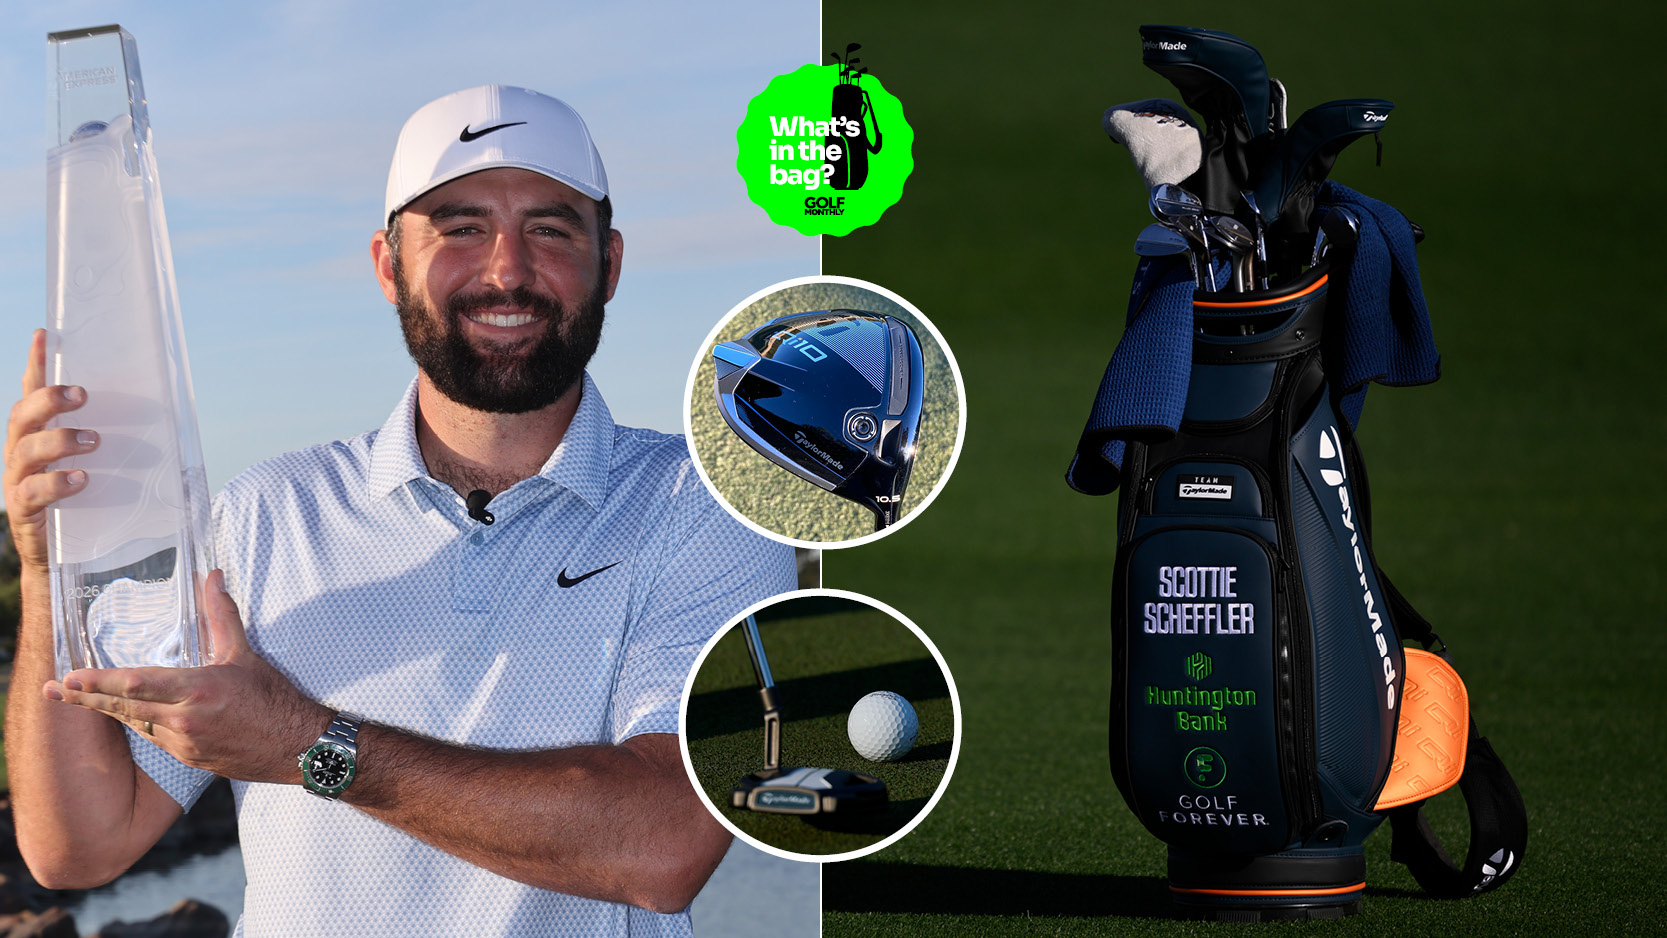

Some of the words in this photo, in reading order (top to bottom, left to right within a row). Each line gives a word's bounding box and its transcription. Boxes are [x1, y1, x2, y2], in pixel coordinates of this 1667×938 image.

[771, 330, 828, 362] Qi10
[794, 430, 844, 470] TaylorMade
[1182, 485, 1228, 495] TaylorMade
[1194, 476, 1219, 484] TEAM
[875, 494, 901, 503] 10.5
[1319, 425, 1396, 710] TaylorMade
[65, 585, 100, 600] 2026
[1158, 566, 1238, 599] SCOTTIE
[1143, 602, 1255, 635] SCHEFFLER
[1145, 685, 1257, 711] Huntington
[1176, 711, 1228, 731] Bank
[1179, 795, 1237, 810] GOLF
